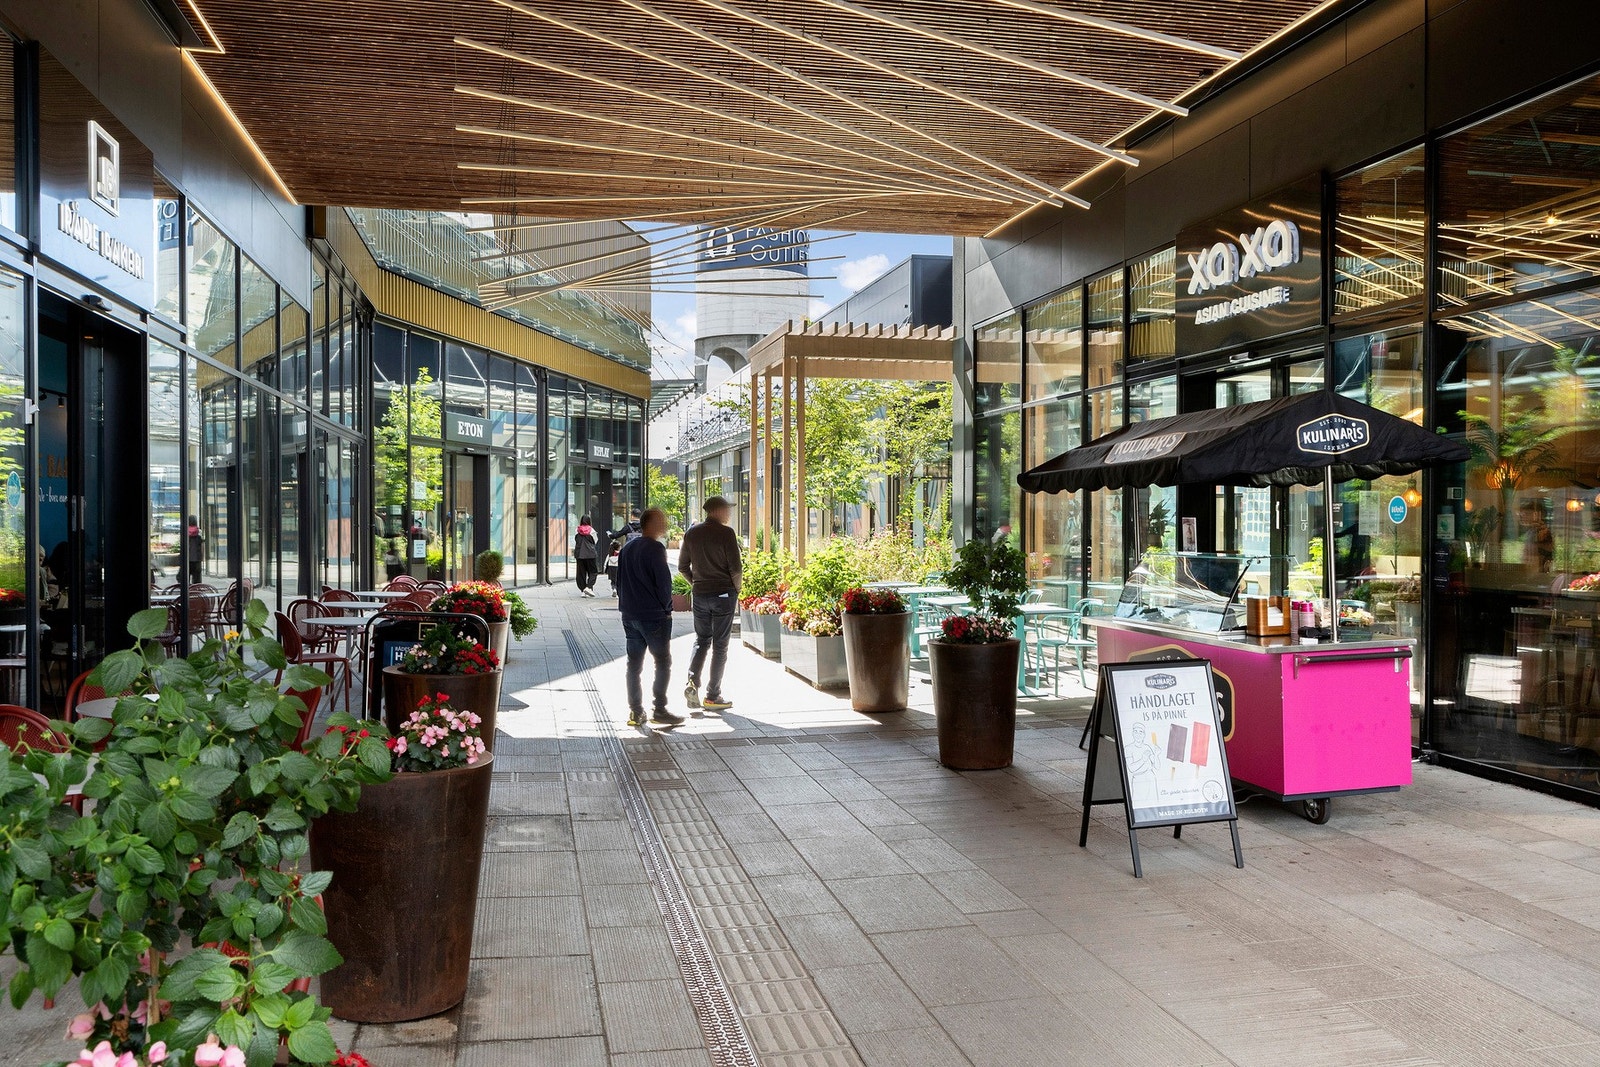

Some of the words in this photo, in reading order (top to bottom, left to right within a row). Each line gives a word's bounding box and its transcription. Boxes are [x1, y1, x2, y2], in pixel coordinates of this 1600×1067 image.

[1195, 302, 1230, 325] ASIAN
[1230, 286, 1290, 316] CUISINE
[457, 421, 483, 438] ETON
[1303, 422, 1364, 444] KULINARIS
[1130, 692, 1195, 709] HÅNDLAGET
[1142, 712, 1150, 721] IS
[1152, 709, 1162, 721] PÅ
[1164, 709, 1187, 720] PINNE
